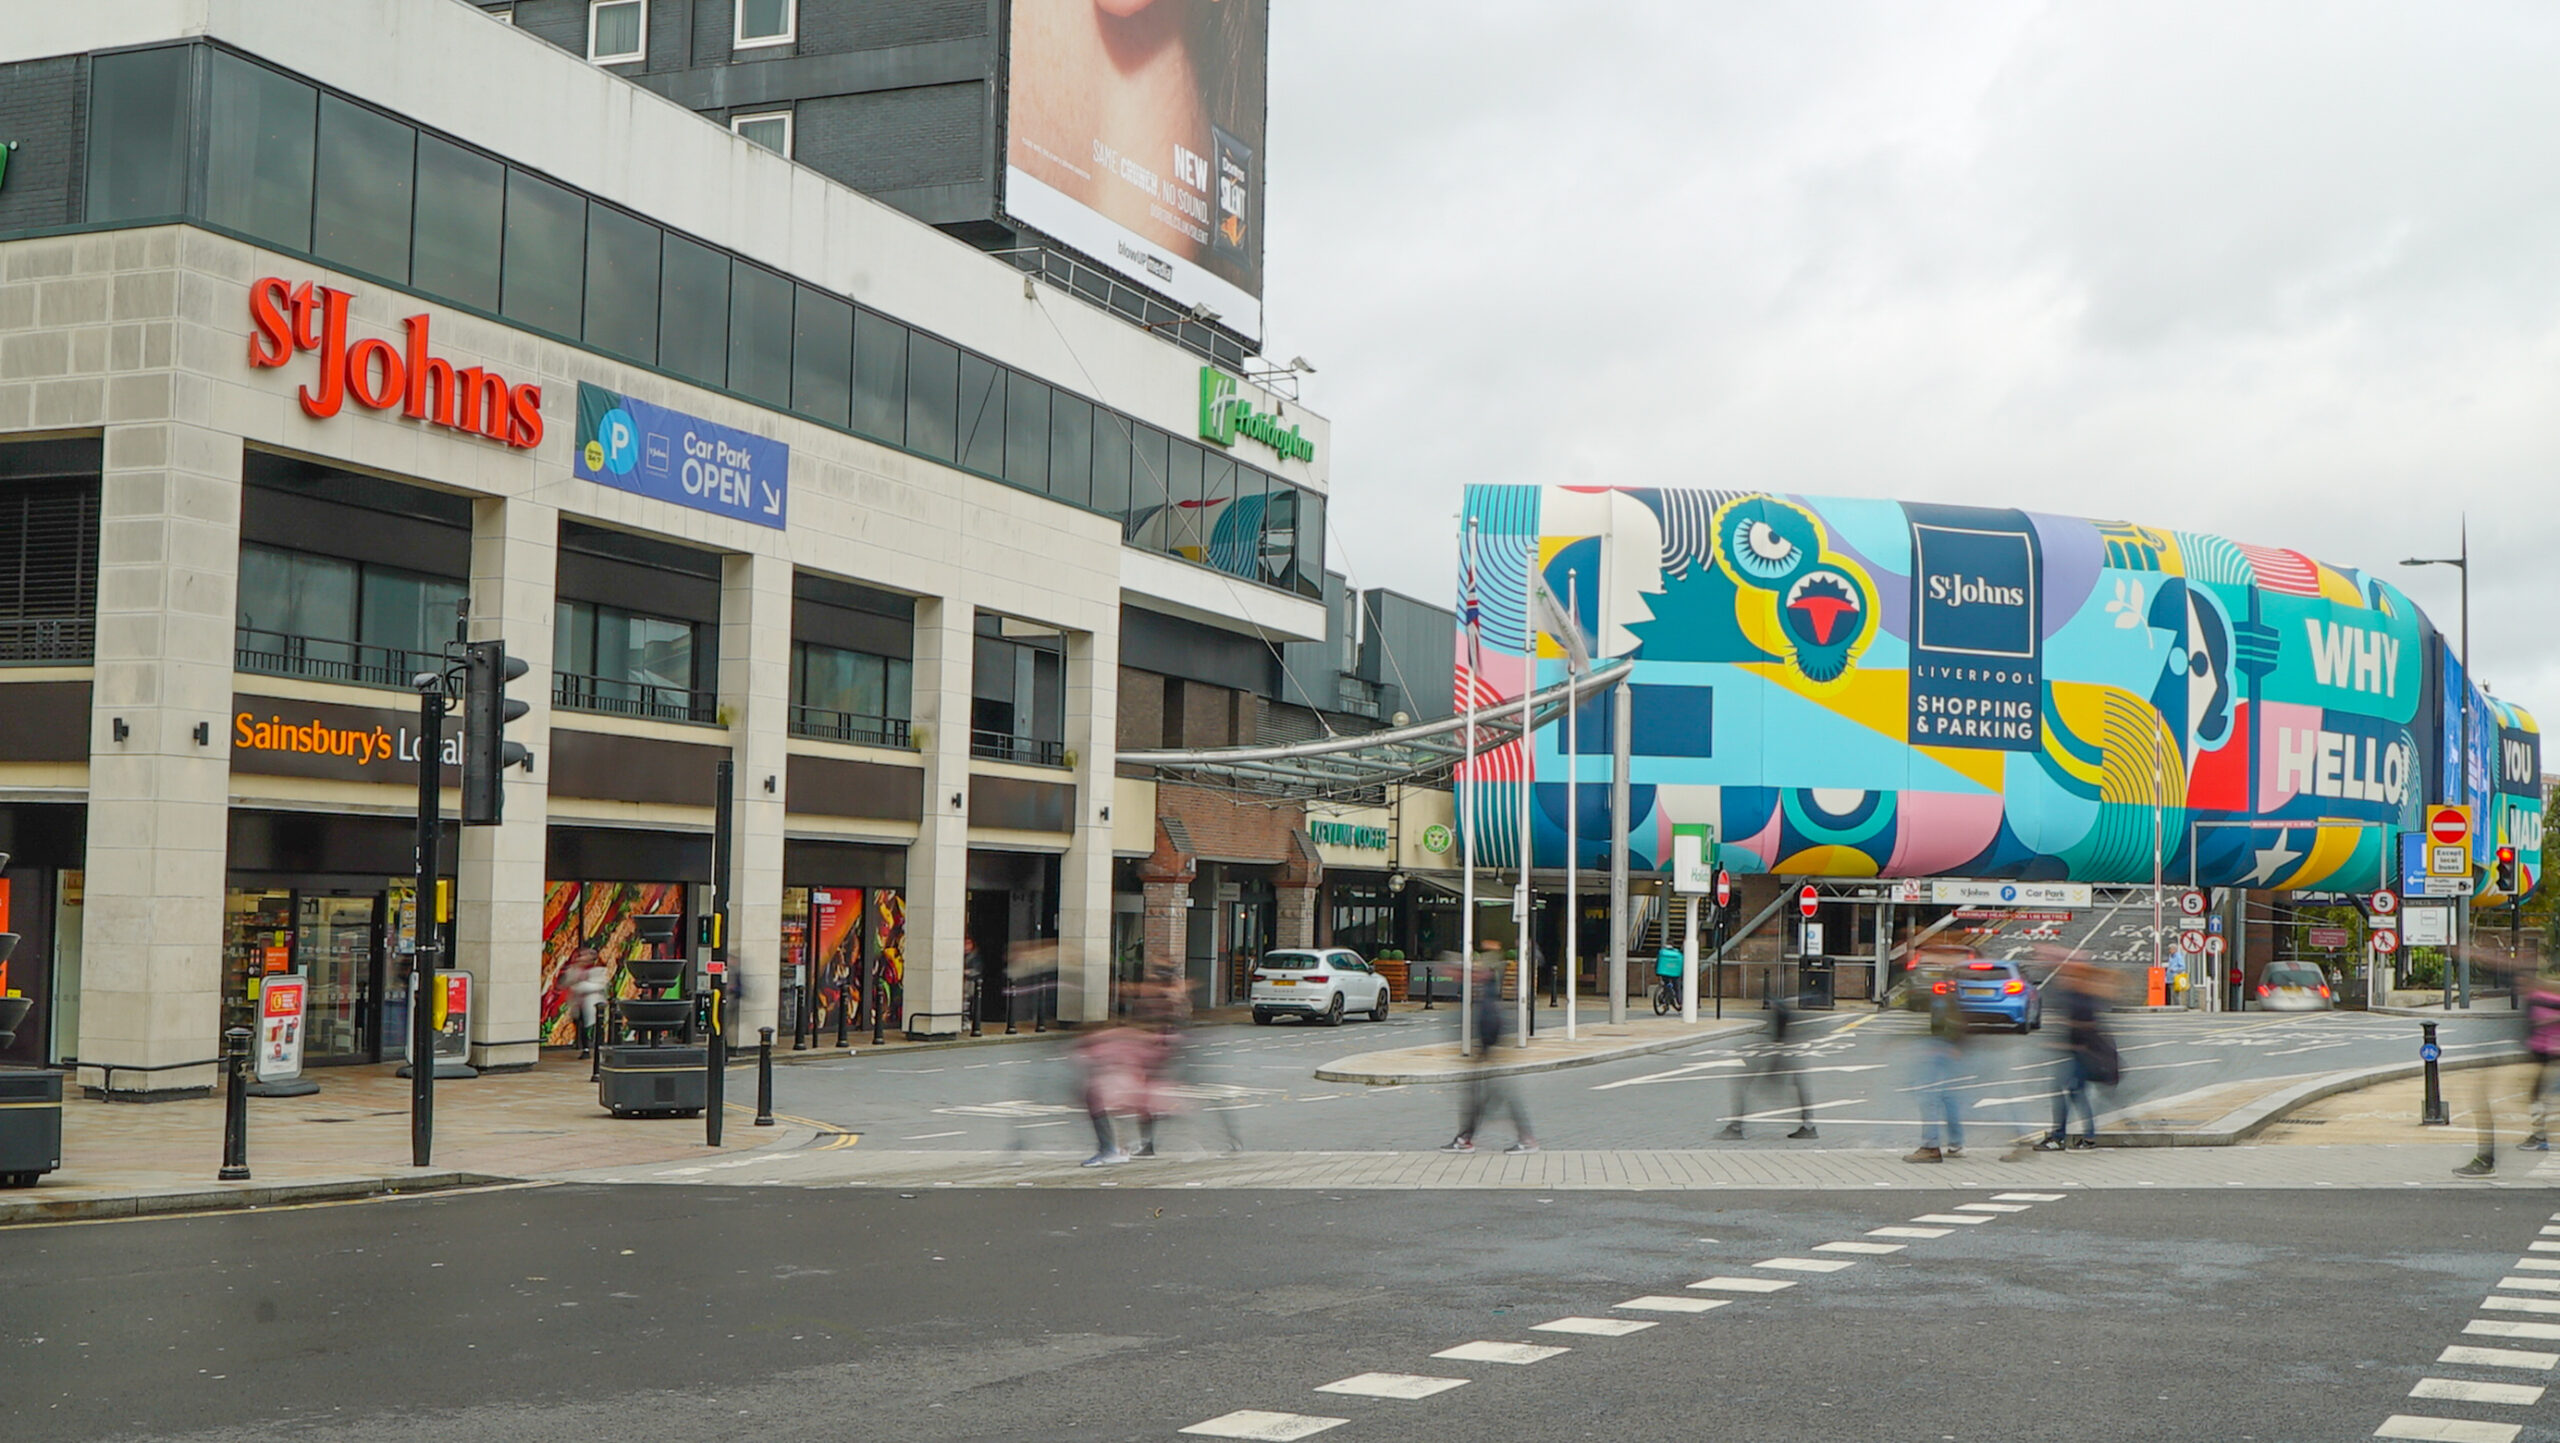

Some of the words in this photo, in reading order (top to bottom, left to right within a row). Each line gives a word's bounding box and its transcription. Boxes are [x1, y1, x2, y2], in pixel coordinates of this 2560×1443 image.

[1092, 138, 1119, 175] SAME
[1162, 178, 1176, 206] NO
[1178, 188, 1209, 226] SOUND.
[1174, 143, 1209, 193] NEW
[683, 431, 714, 460] Car
[717, 440, 751, 471] Park
[681, 458, 751, 509] OPEN
[1917, 665, 2034, 685] LIVERPOOL
[2305, 618, 2399, 699] WHY
[1917, 694, 2033, 719] SHOPPING
[235, 712, 393, 766] Sainsbury's
[398, 727, 464, 766] Loal
[1916, 715, 1929, 733] &
[1936, 717, 2033, 740] PARKING
[2503, 738, 2532, 784] YOU
[1311, 820, 1333, 845] KEY
[2510, 808, 2542, 851] MAD
[2025, 888, 2043, 897] Car
[2045, 889, 2065, 898] Park
[2188, 898, 2197, 909] 5
[2379, 896, 2388, 908] 5
